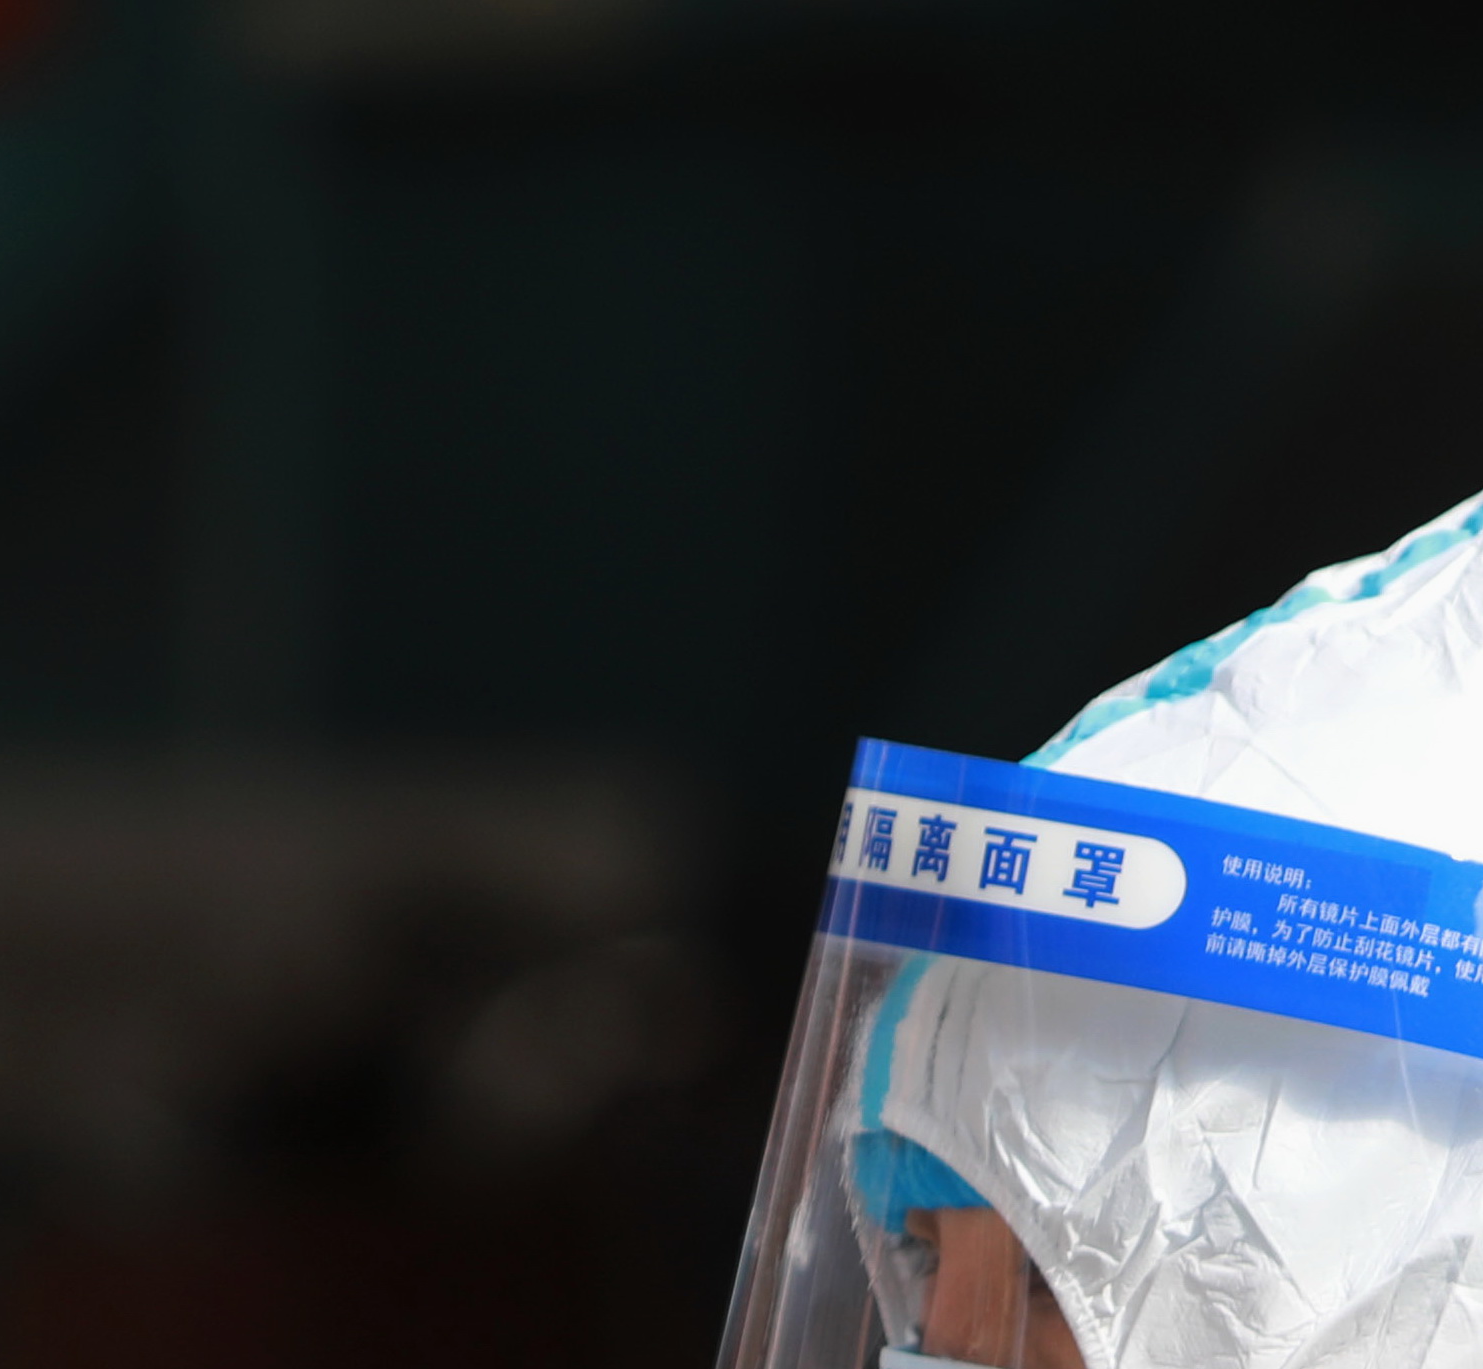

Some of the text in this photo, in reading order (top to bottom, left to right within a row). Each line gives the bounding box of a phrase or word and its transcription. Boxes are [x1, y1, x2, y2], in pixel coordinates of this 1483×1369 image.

[1205, 932, 1431, 998] 前请撕掉外层保护膜佩戴
